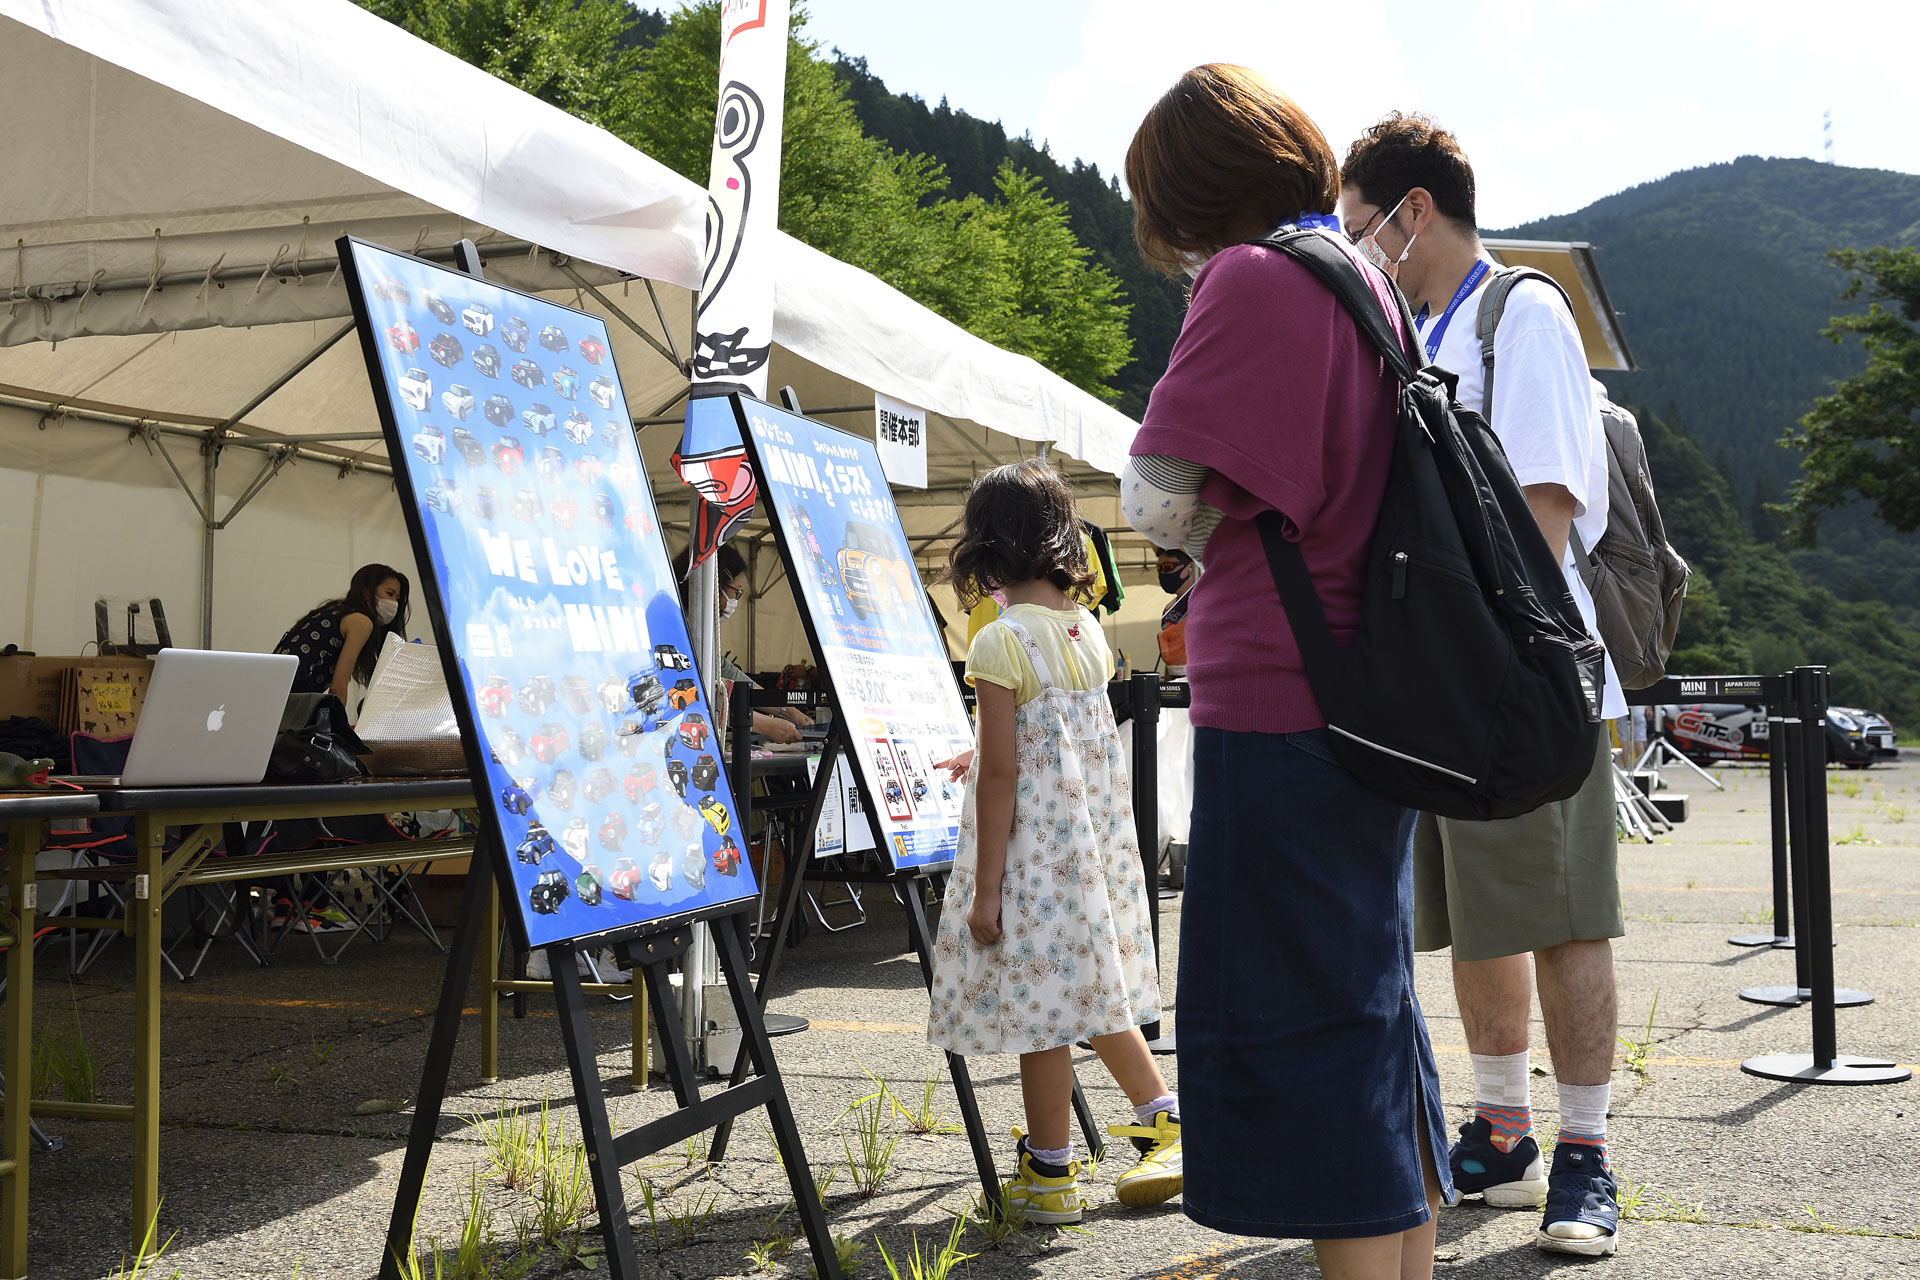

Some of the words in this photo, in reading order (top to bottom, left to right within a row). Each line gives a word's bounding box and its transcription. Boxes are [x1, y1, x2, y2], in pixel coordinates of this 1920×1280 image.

[752, 416, 794, 446] あなたの
[880, 410, 920, 448] 開催本部
[763, 443, 823, 494] MINI
[824, 457, 872, 496] イラスト
[479, 528, 539, 584] WE
[542, 537, 624, 591] LOVE
[564, 604, 652, 652] MINI
[787, 692, 807, 700] MINI
[1681, 682, 1706, 691] MINI
